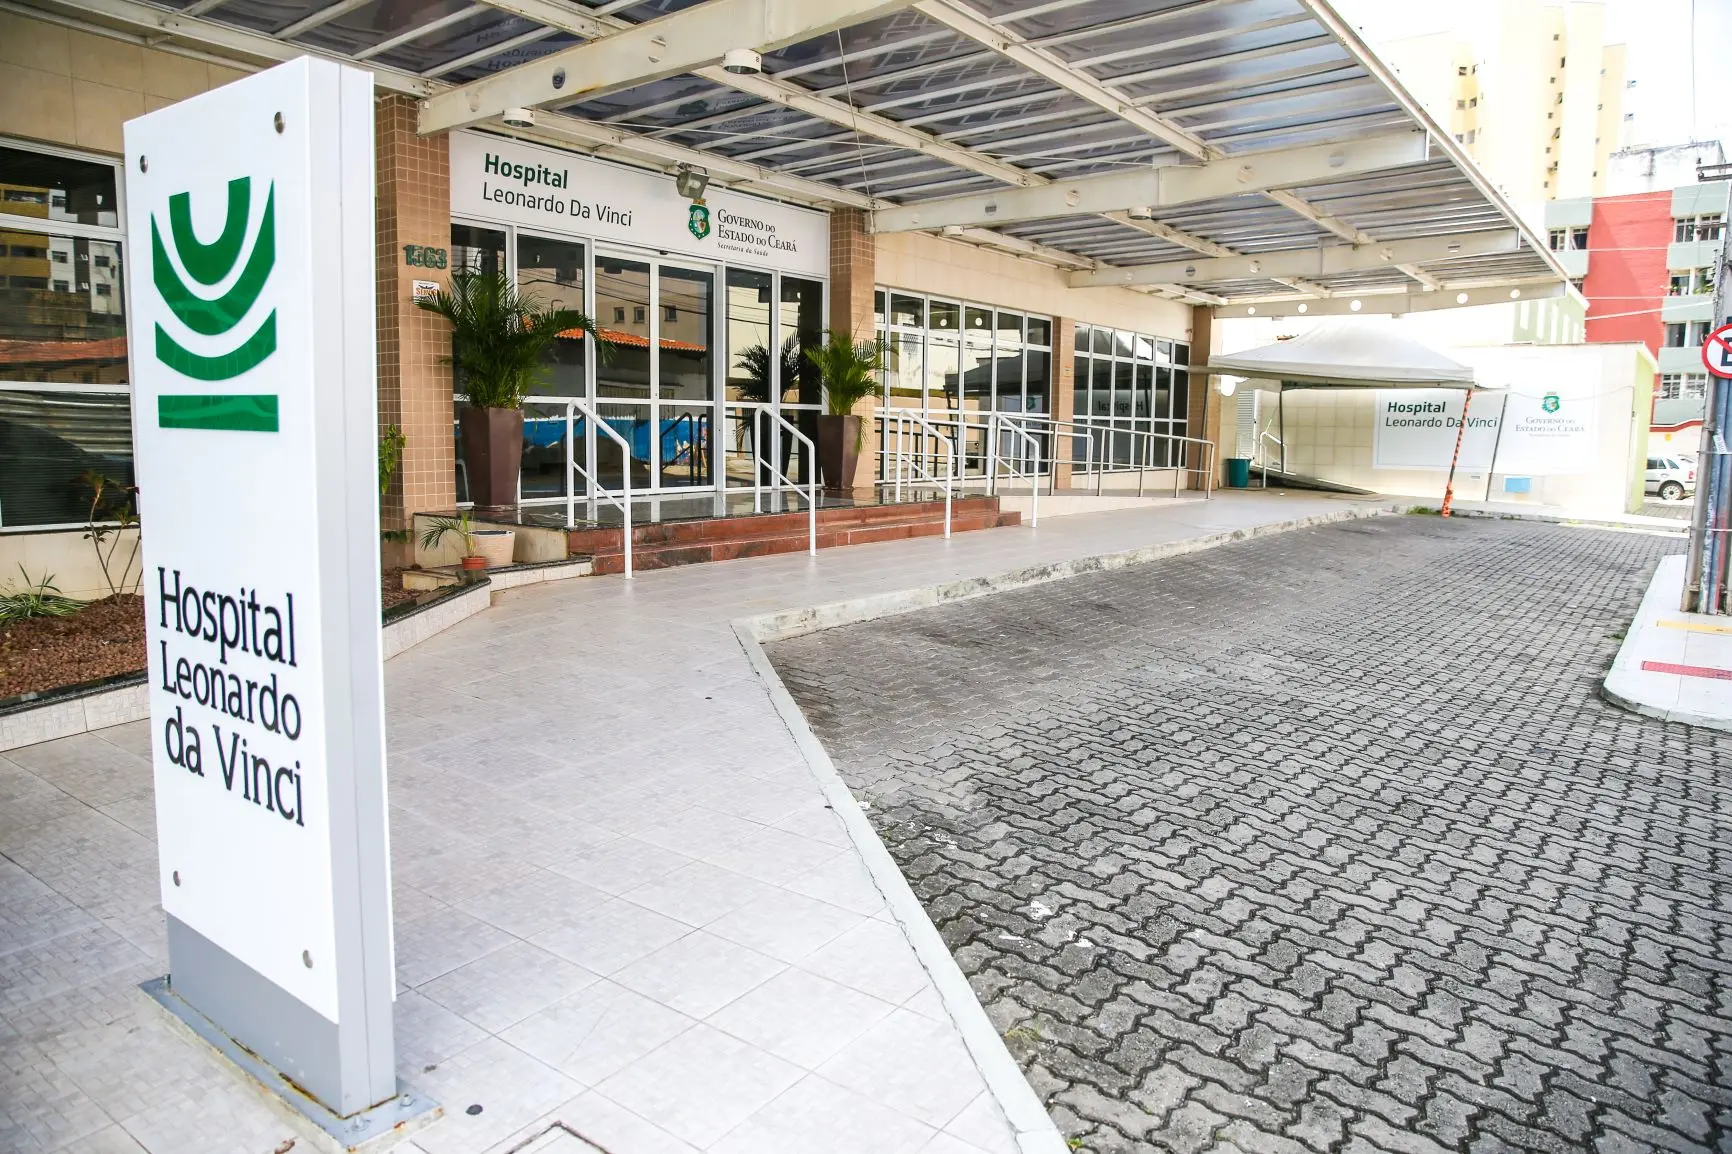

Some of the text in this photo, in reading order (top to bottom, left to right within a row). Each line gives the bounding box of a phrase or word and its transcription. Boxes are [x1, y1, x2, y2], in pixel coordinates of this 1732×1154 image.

[484, 153, 568, 189] Hospital
[483, 181, 632, 227] Leonardo Da Vinci
[717, 208, 764, 231] GOVERNO
[718, 224, 755, 244] ESTADO
[403, 244, 448, 270] 1563
[1385, 416, 1498, 428] Leonardo Da Vinci
[1387, 401, 1446, 416] Hospital
[158, 566, 297, 667] Hospital
[160, 640, 301, 740] Leonardo
[165, 705, 304, 827] da Vinci
